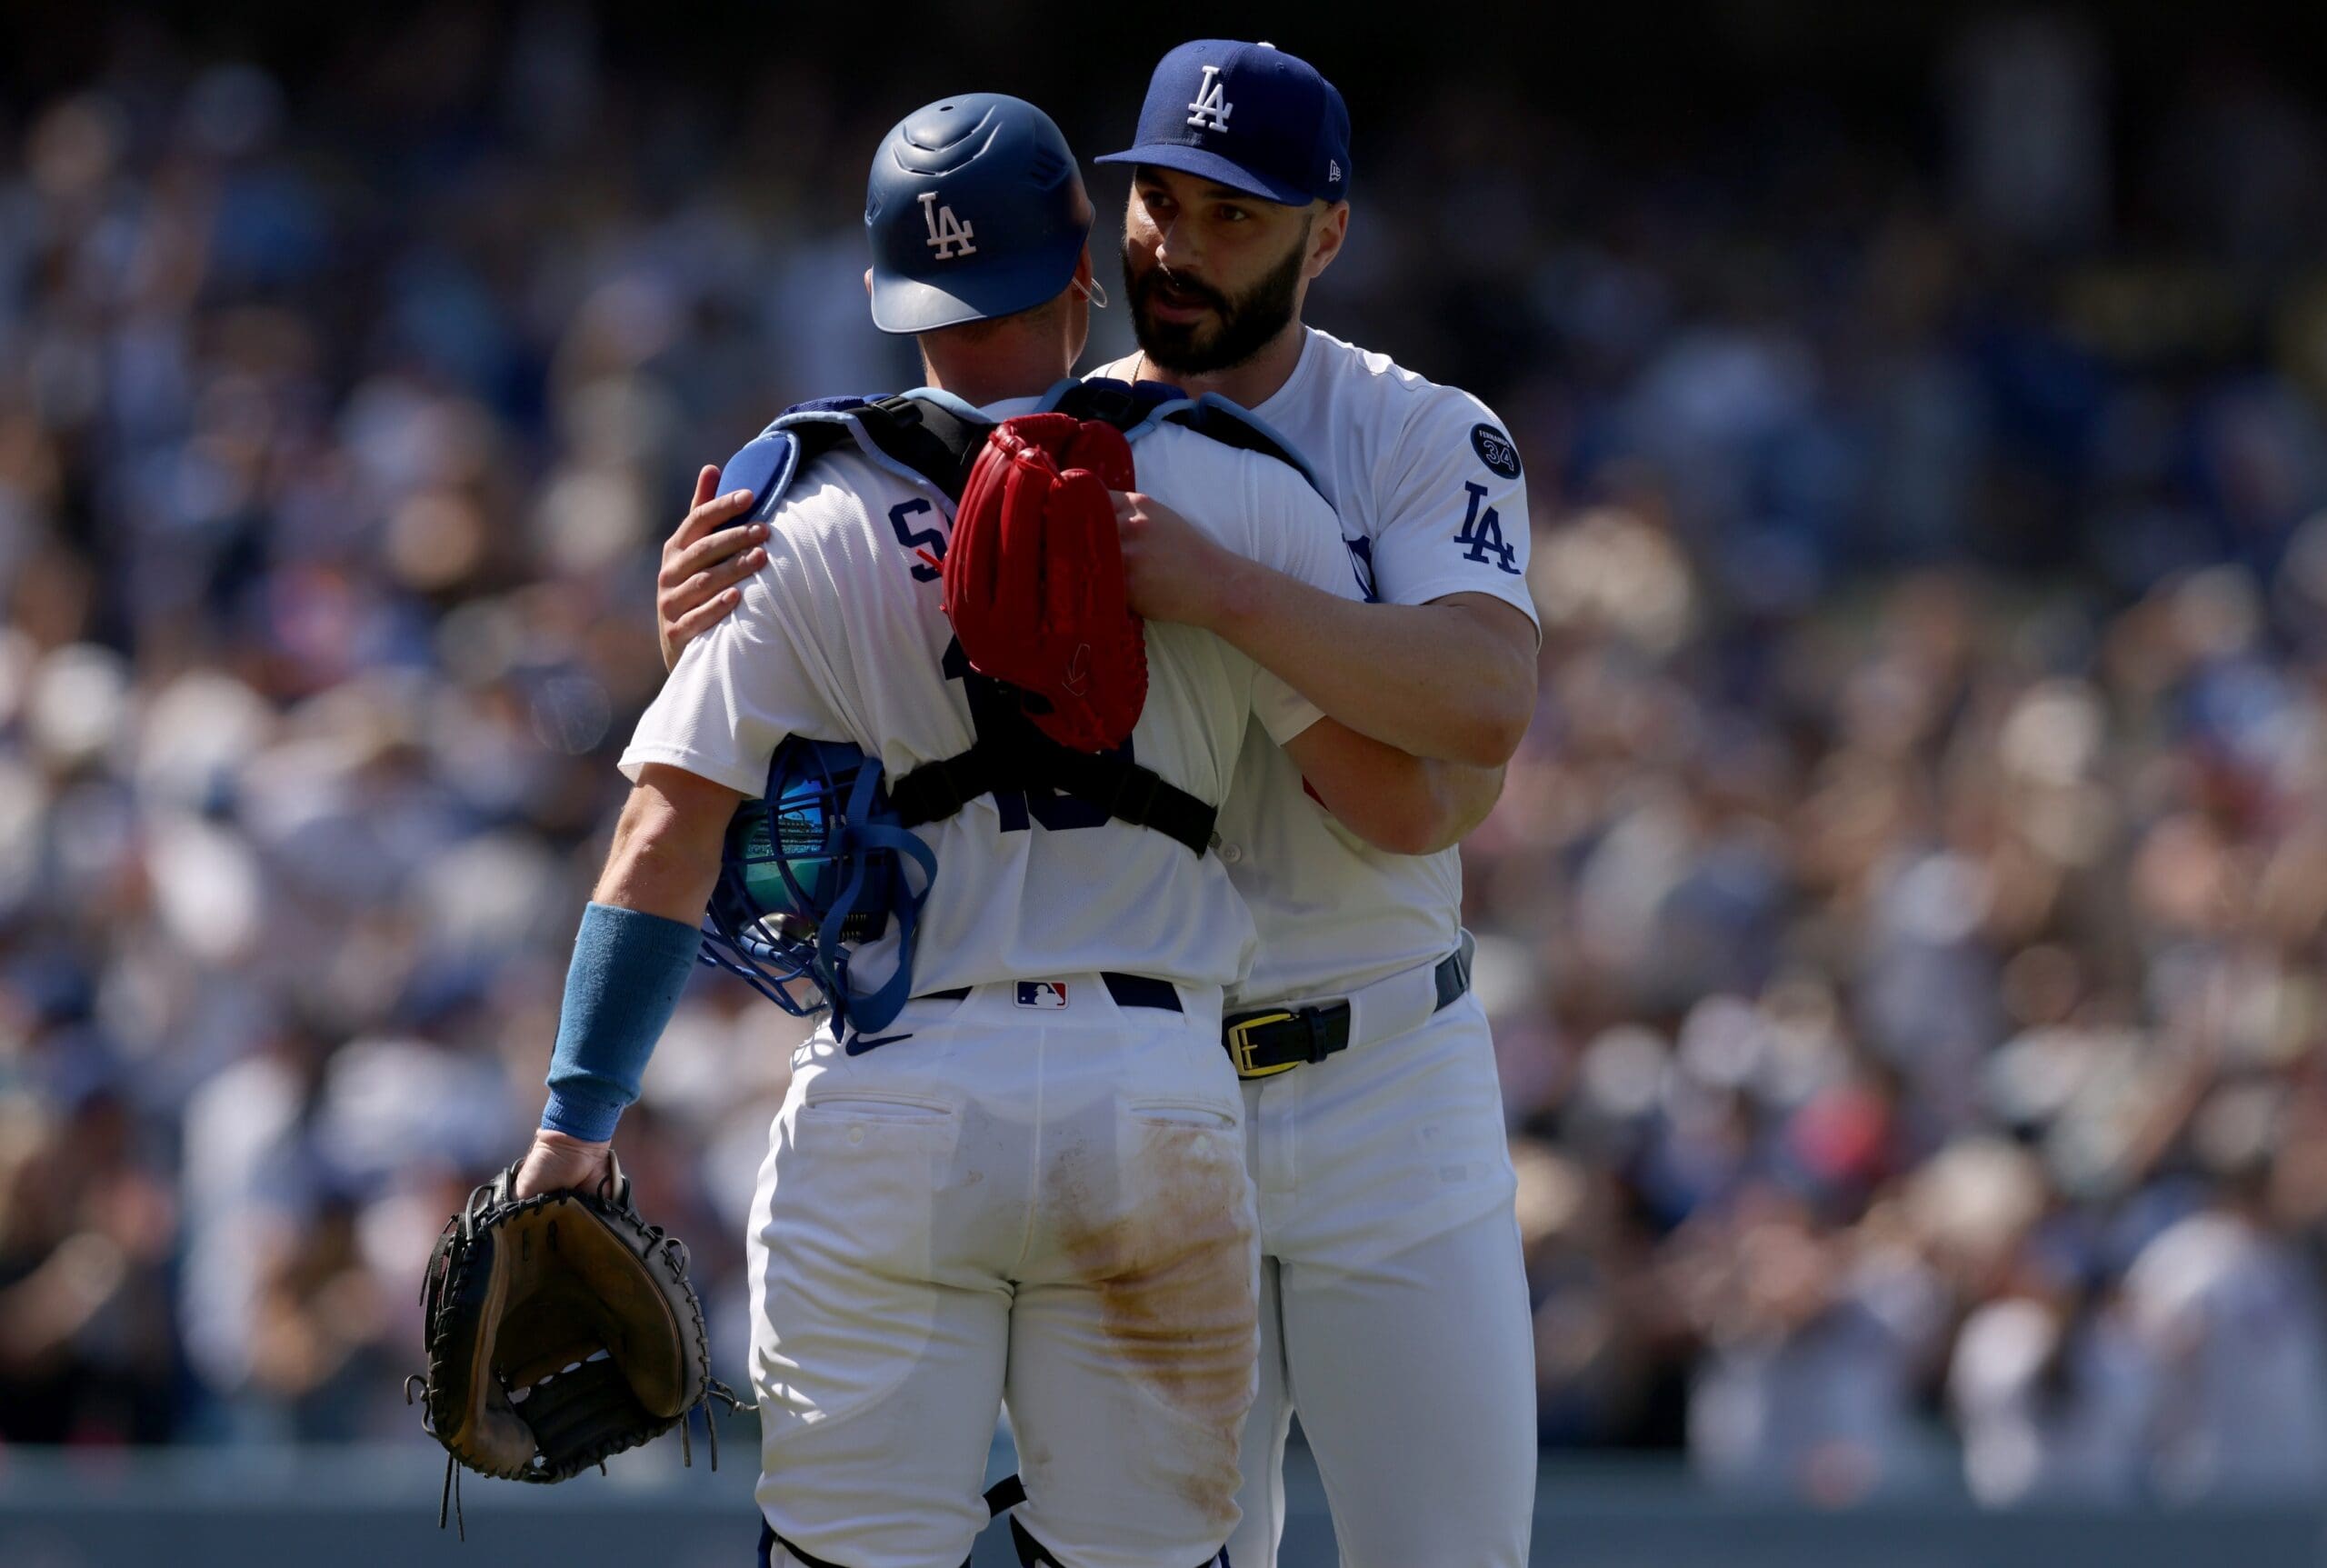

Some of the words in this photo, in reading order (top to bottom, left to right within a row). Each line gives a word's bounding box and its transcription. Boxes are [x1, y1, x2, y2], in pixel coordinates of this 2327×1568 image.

[1186, 65, 1233, 134] LA
[917, 192, 977, 260] LA
[1483, 439, 1514, 473] 34
[1453, 480, 1522, 575] LA
